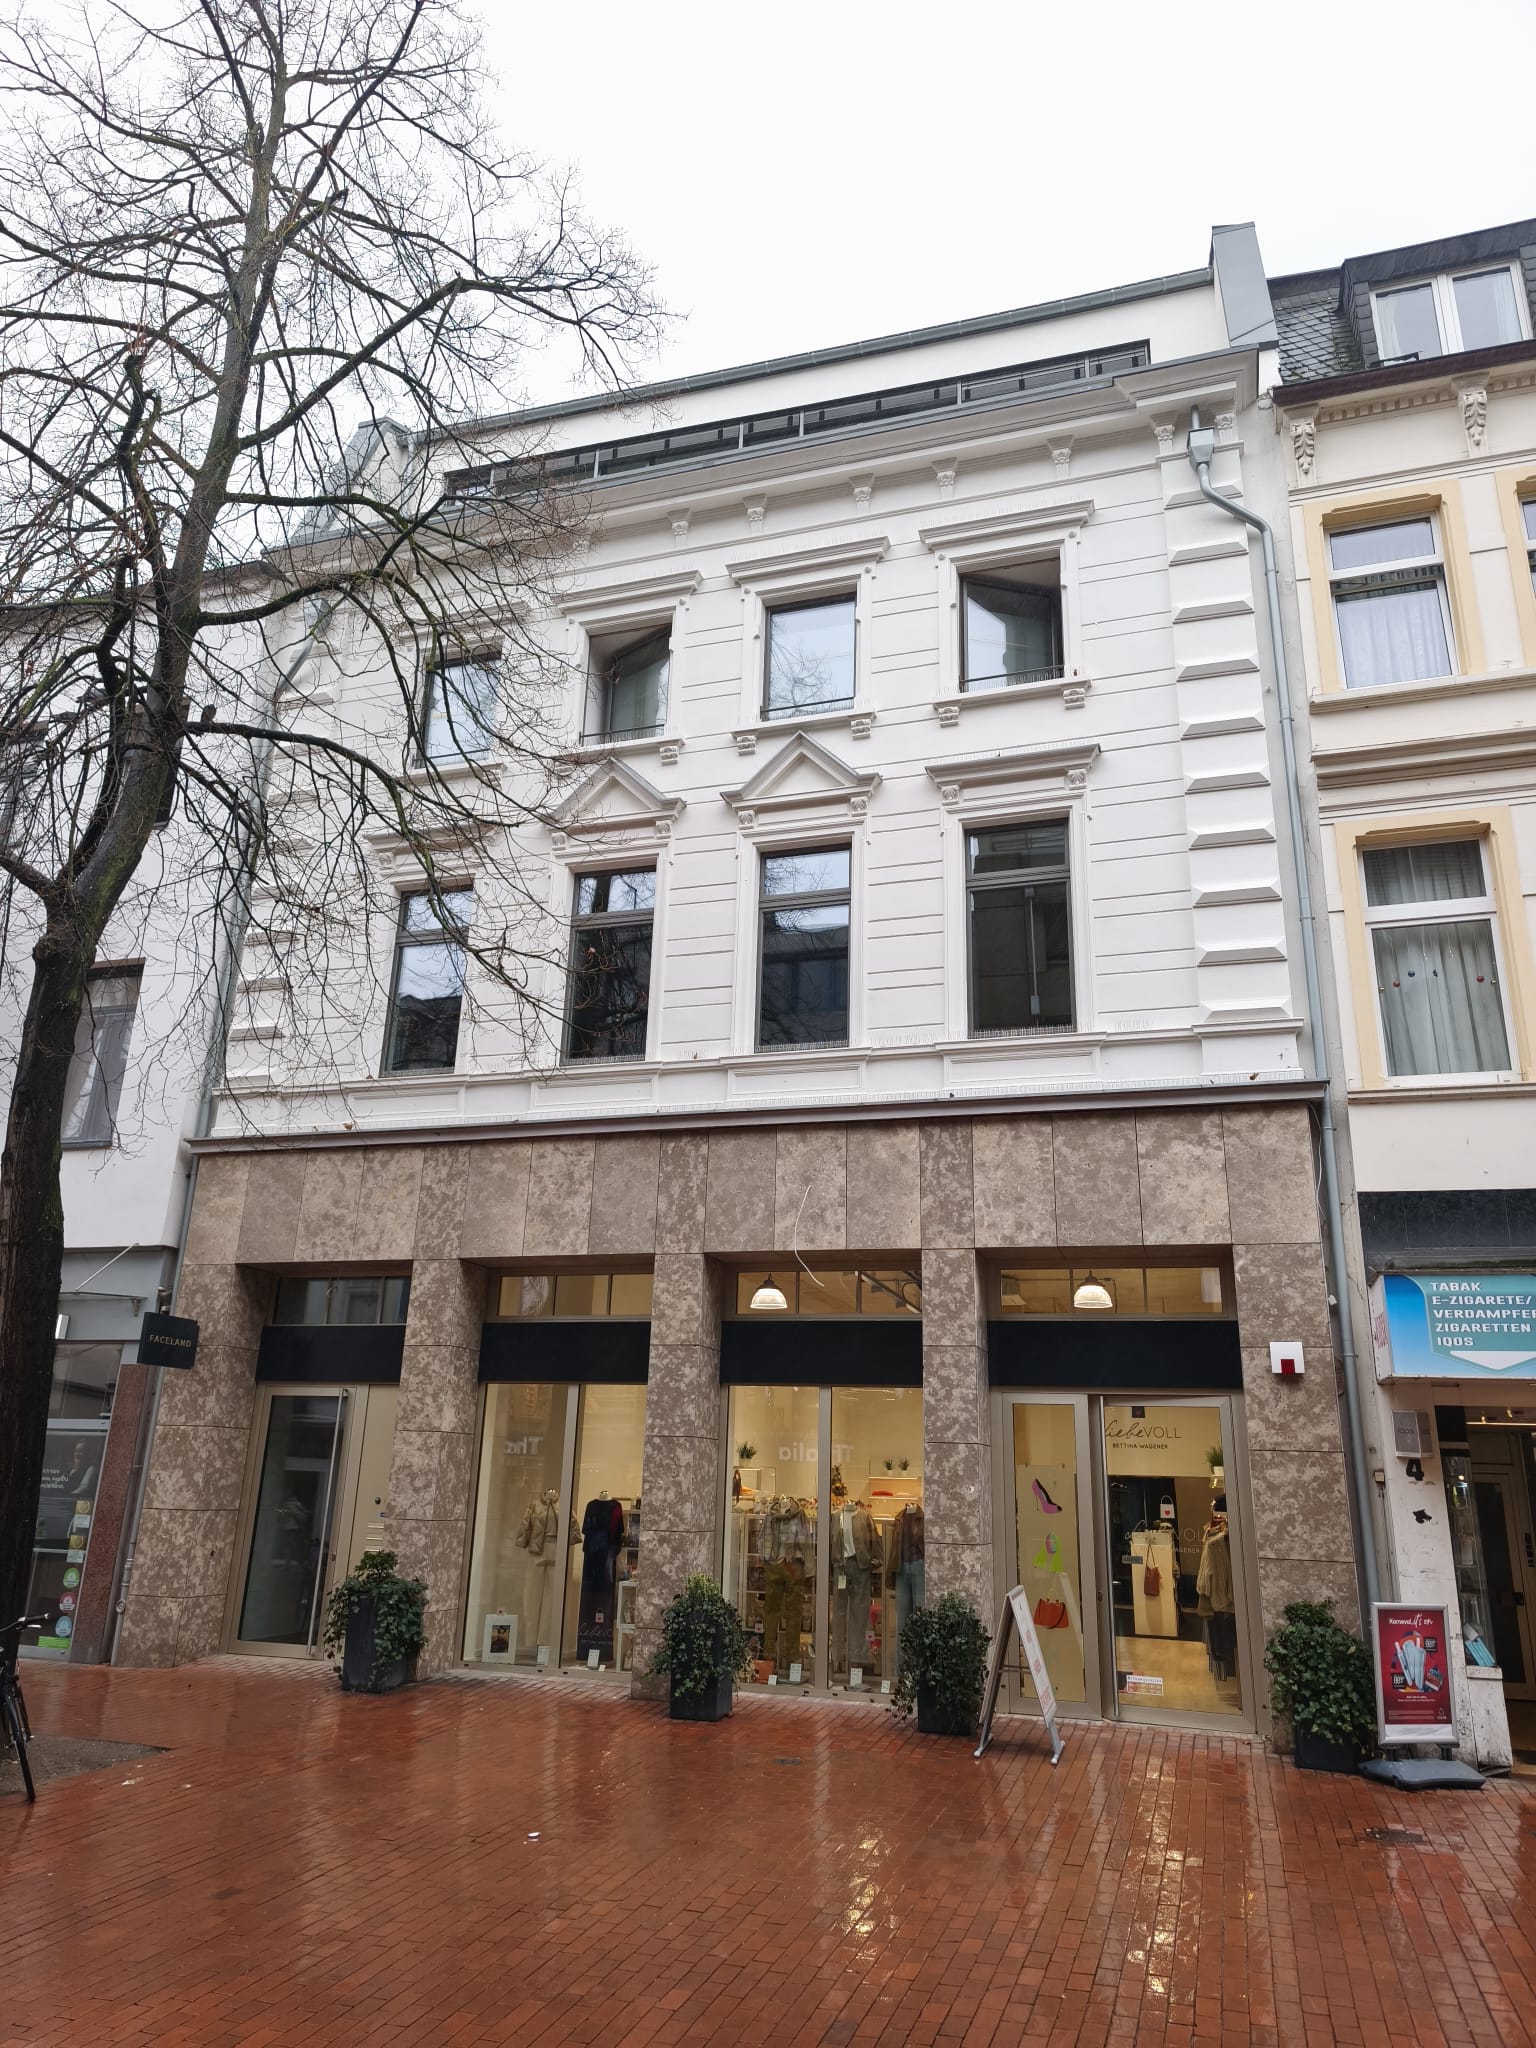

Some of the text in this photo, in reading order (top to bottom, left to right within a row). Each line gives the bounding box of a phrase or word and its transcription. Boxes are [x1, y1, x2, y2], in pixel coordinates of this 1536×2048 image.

[1430, 1282, 1481, 1291] TABAK
[1432, 1296, 1532, 1305] E-ZIGARETE/
[1436, 1323, 1531, 1333] ZIGARETTEN
[149, 1334, 192, 1348] FACELAND
[1437, 1337, 1474, 1346] IQOS
[1406, 1458, 1425, 1481] 4
